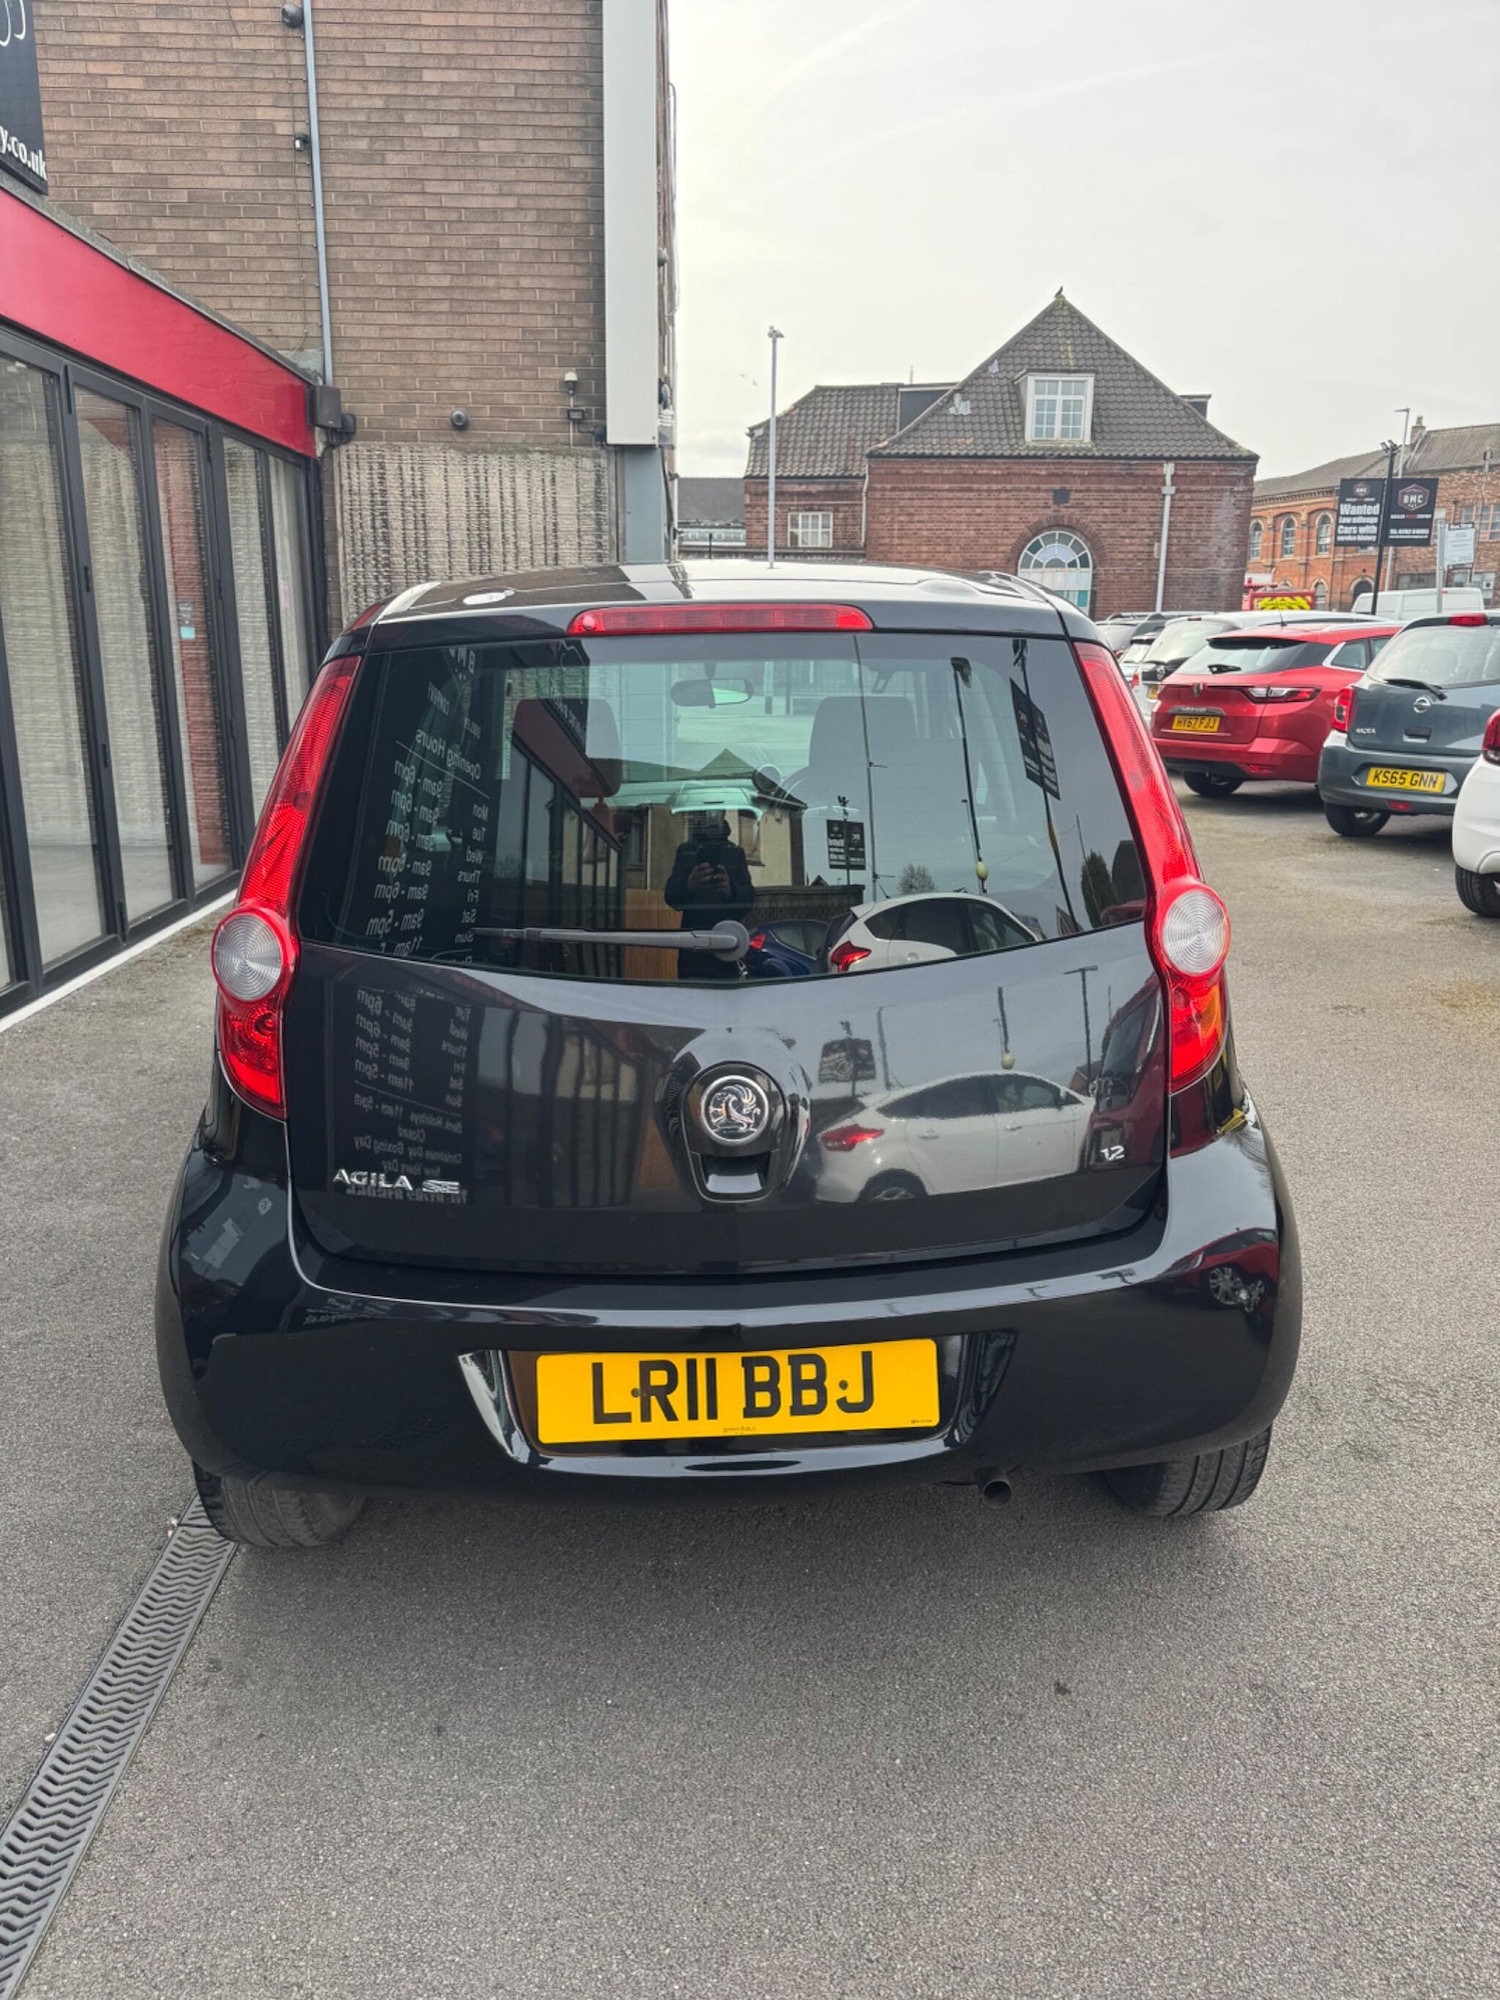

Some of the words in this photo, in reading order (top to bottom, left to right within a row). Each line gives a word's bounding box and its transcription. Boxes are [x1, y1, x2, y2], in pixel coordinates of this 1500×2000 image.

[1340, 503, 1380, 515] Wanted
[1337, 525, 1357, 534] Cars
[1358, 525, 1378, 534] with
[1372, 769, 1408, 786] KS65
[1409, 773, 1439, 789] GNN
[333, 1168, 413, 1191] AGILA
[592, 1357, 719, 1425] LR11
[742, 1350, 875, 1419] BBJ
